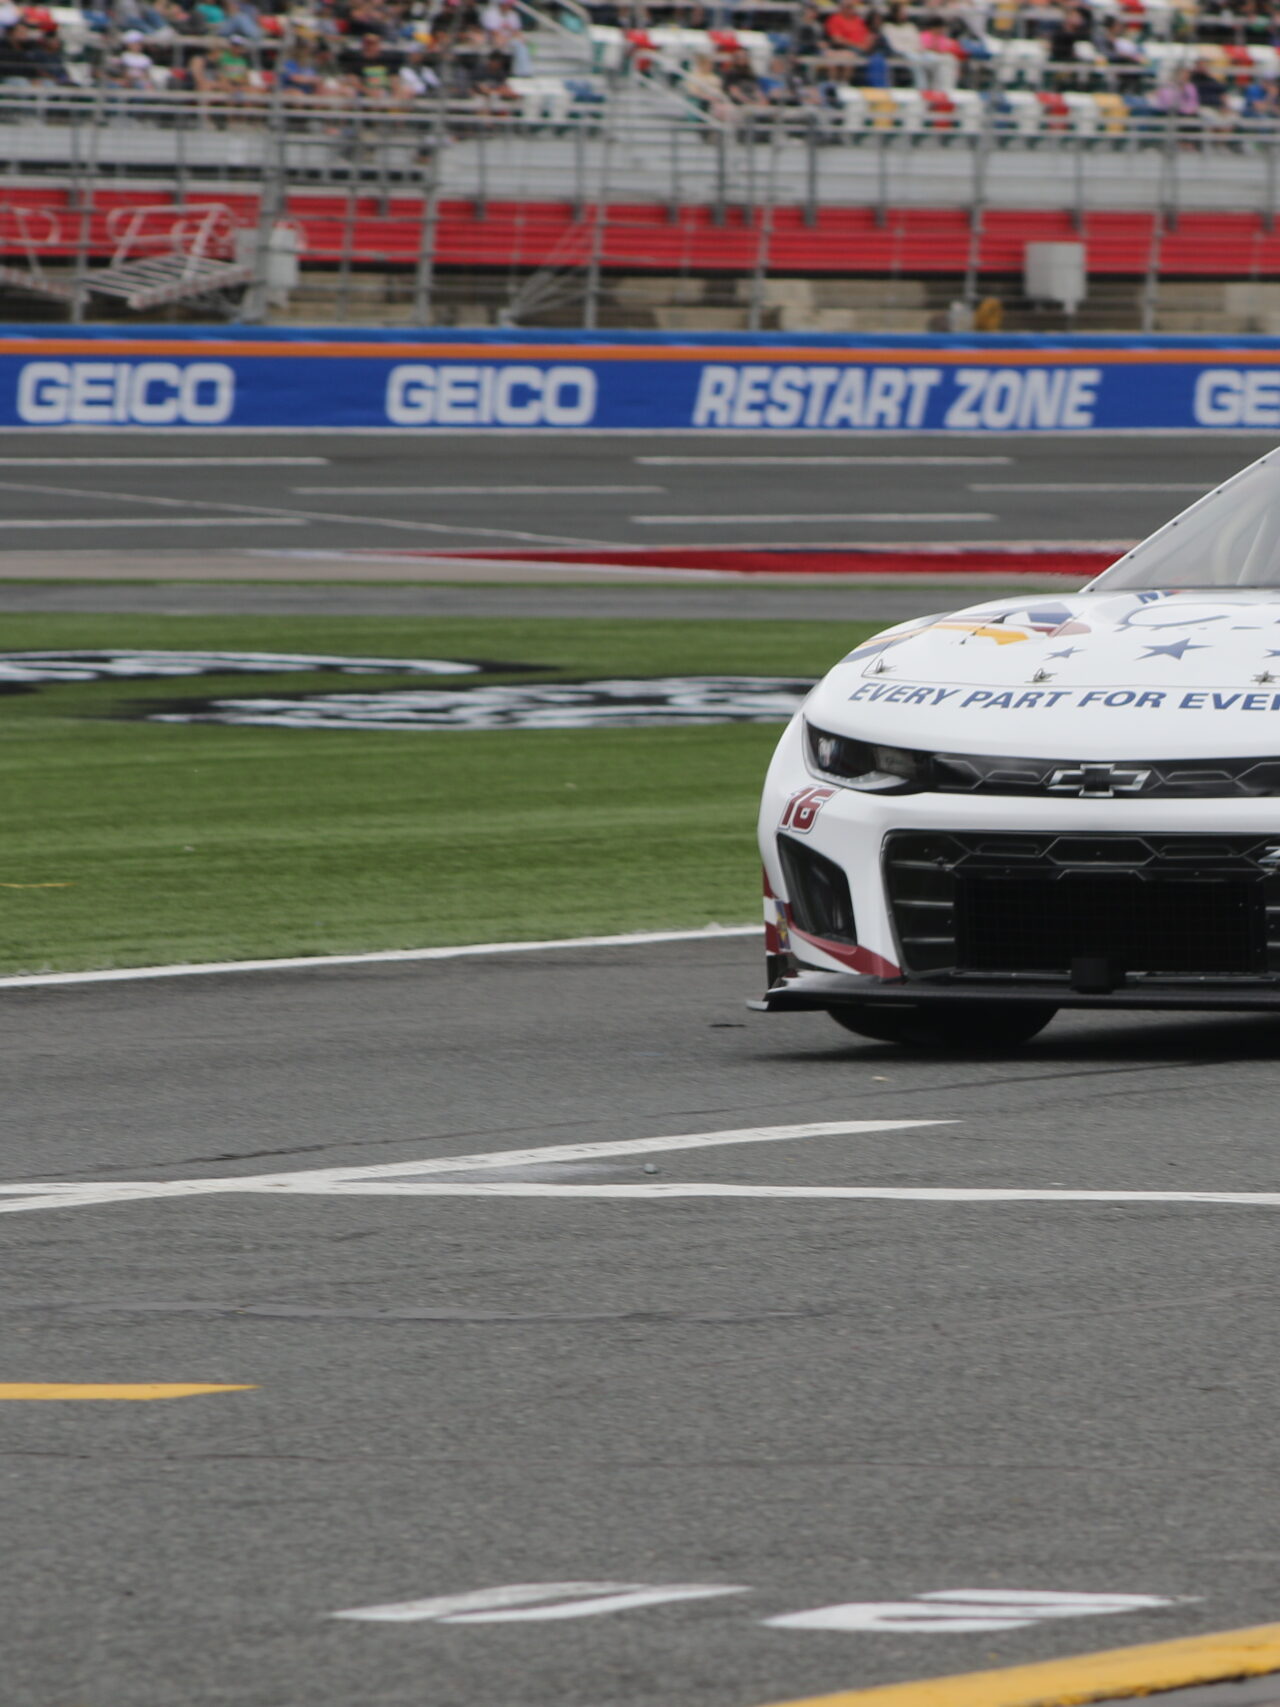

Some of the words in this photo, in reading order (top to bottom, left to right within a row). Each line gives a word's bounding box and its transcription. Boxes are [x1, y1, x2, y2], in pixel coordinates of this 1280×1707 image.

[17, 362, 235, 424] GEICO
[386, 366, 597, 426] GEICO
[692, 365, 943, 428] RESTART
[945, 369, 1101, 429] ZONE
[848, 683, 961, 706] EVERY
[959, 690, 1073, 710] PART
[1077, 690, 1164, 710] FOR
[778, 785, 836, 833] 16
